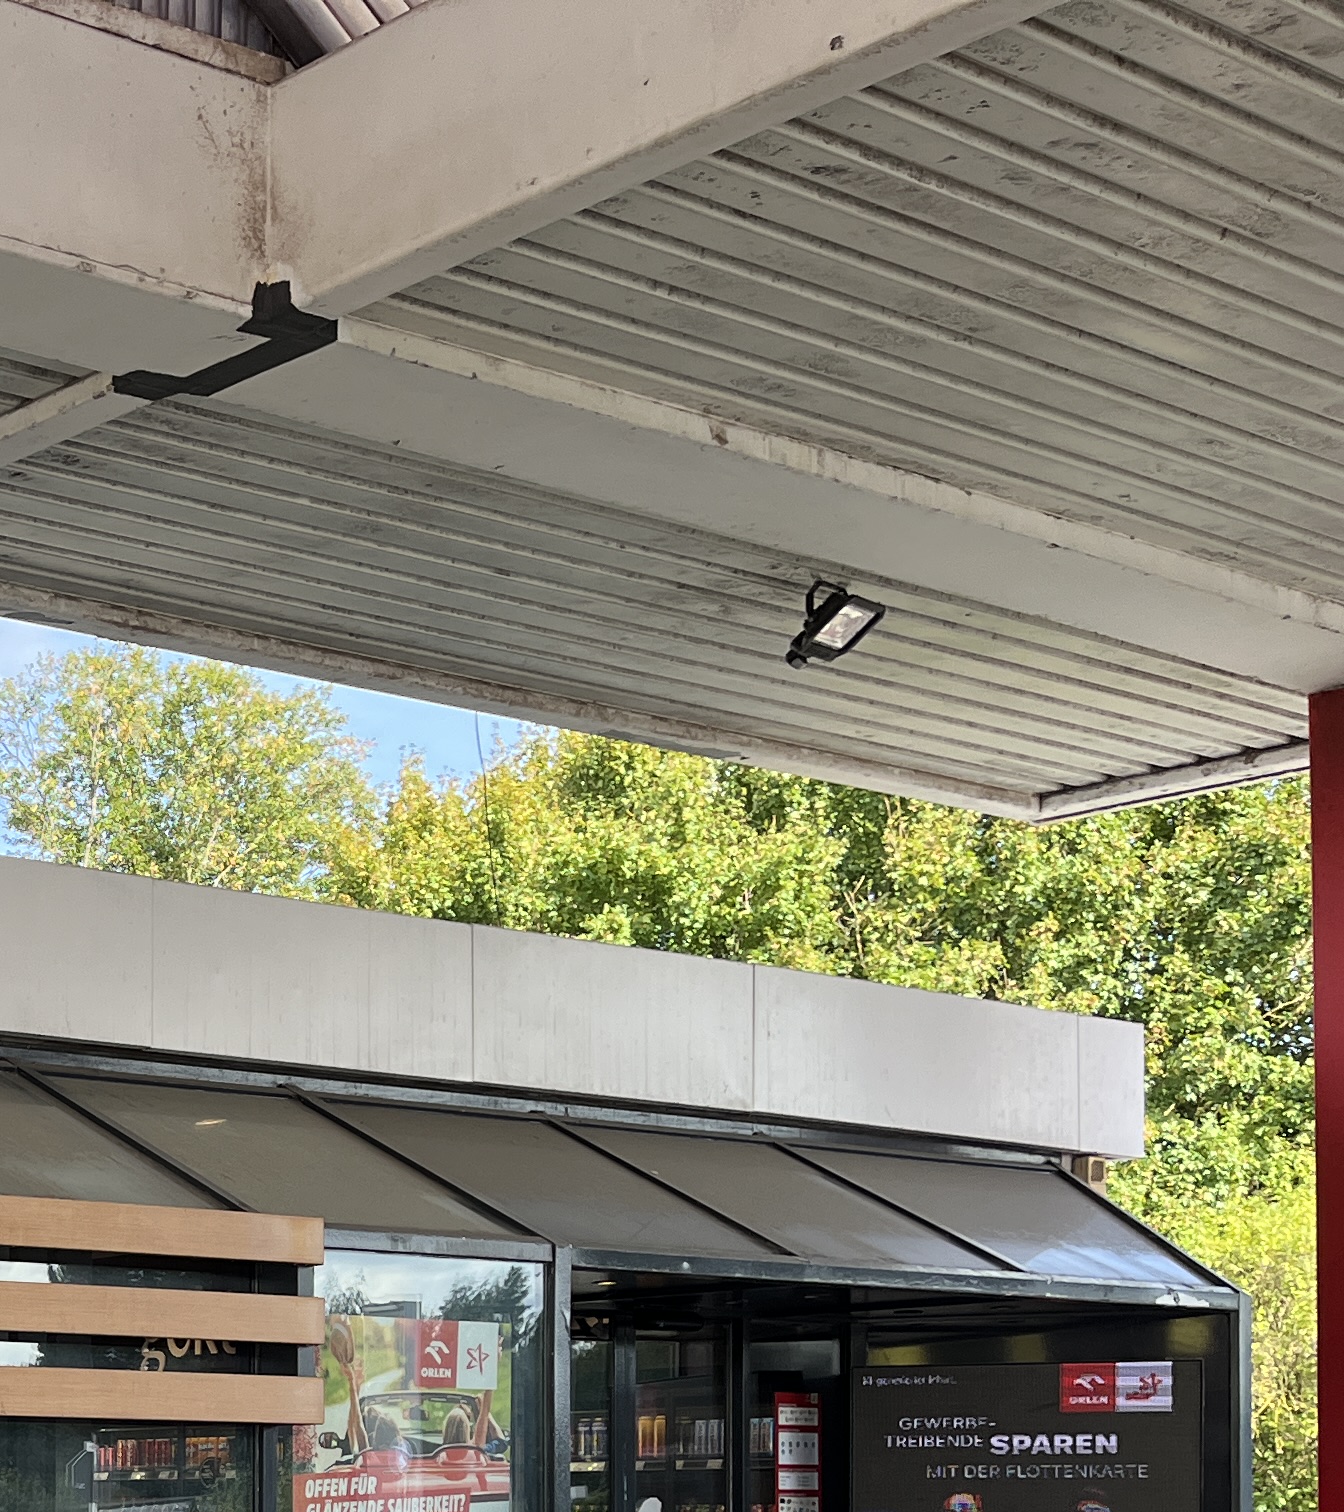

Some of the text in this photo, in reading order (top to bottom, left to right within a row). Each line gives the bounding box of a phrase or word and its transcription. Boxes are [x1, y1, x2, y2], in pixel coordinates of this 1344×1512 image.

[421, 1367, 452, 1378] ORLEN
[990, 1434, 1118, 1455] SPAREN
[926, 1464, 1149, 1479] MIT DER FLOTTENKARTE
[305, 1475, 377, 1498] OFFEN FÜR
